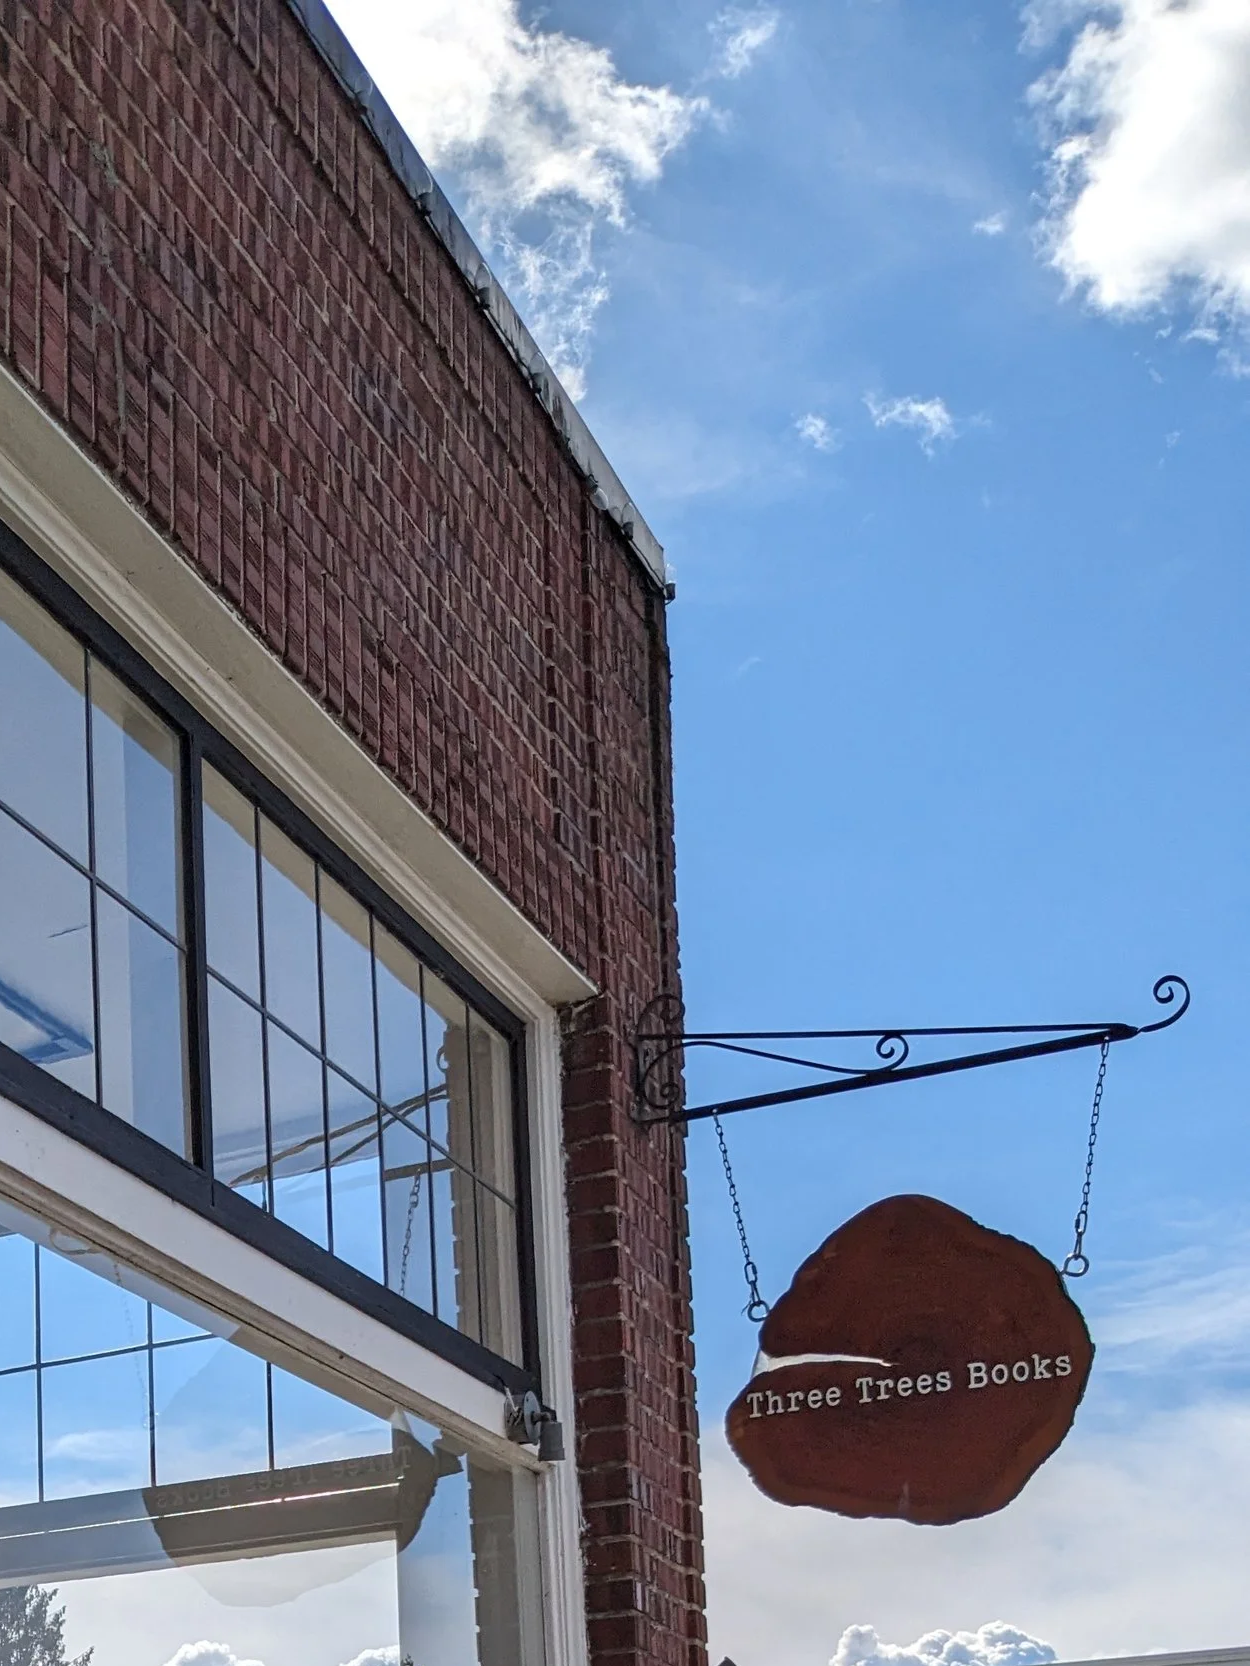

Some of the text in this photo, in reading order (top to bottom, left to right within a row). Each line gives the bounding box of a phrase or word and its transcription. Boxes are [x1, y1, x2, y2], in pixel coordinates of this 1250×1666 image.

[747, 1353, 1072, 1419] Three Trees Books
